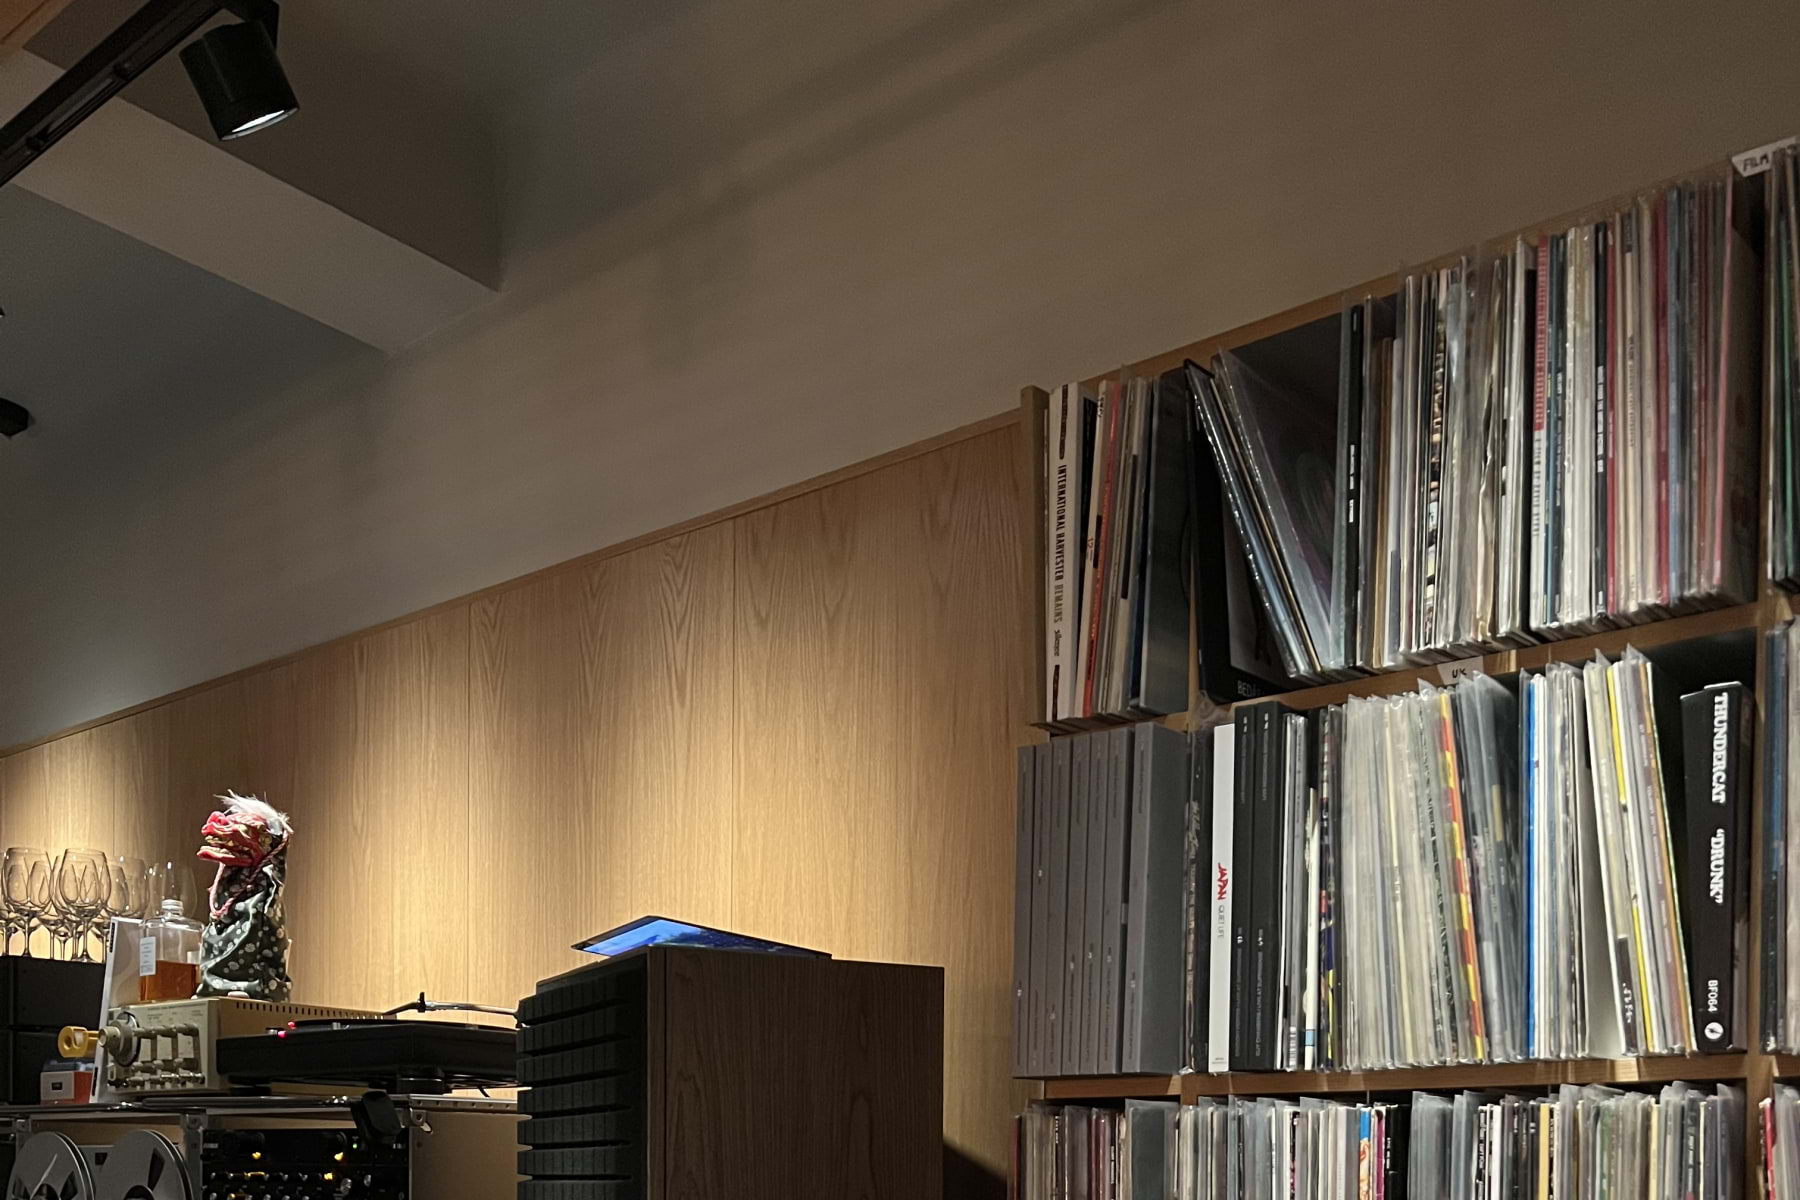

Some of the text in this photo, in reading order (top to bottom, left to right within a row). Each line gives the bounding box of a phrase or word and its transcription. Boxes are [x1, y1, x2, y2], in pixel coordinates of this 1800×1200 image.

[1055, 465, 1067, 531] INTERNATIONAL
[1054, 533, 1064, 581] HARVESTER
[1053, 584, 1063, 623] REMAINS
[1452, 668, 1467, 678] UK
[1710, 692, 1728, 804] THUNDERCAT
[1216, 862, 1228, 938] JAPAN QUIET LIFE
[1706, 980, 1719, 1012] BF064
